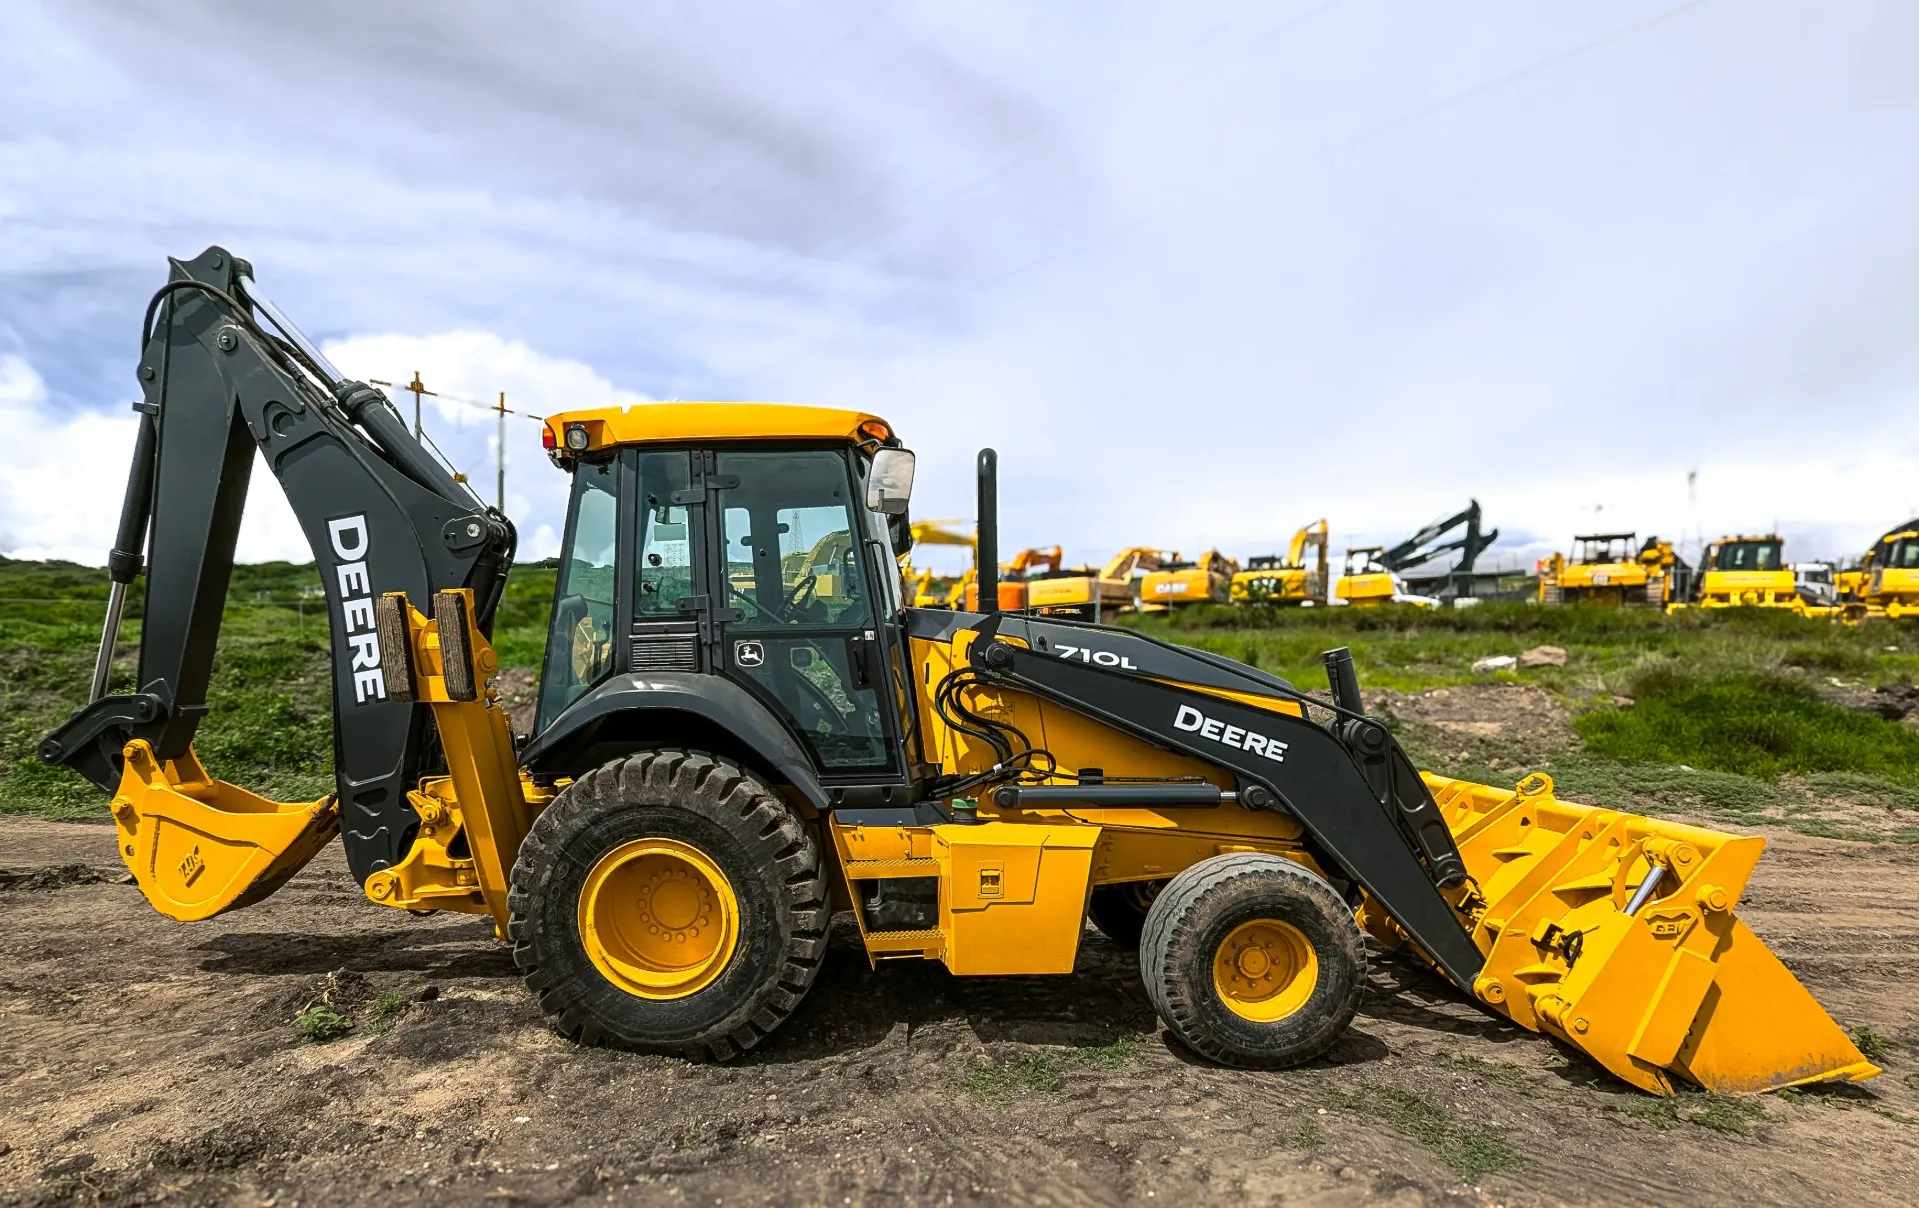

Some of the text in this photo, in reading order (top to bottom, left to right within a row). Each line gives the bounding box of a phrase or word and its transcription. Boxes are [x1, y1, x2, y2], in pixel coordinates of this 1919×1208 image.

[328, 514, 386, 703] DEERE
[1054, 644, 1138, 671] 710L
[1173, 704, 1289, 763] DEERE
